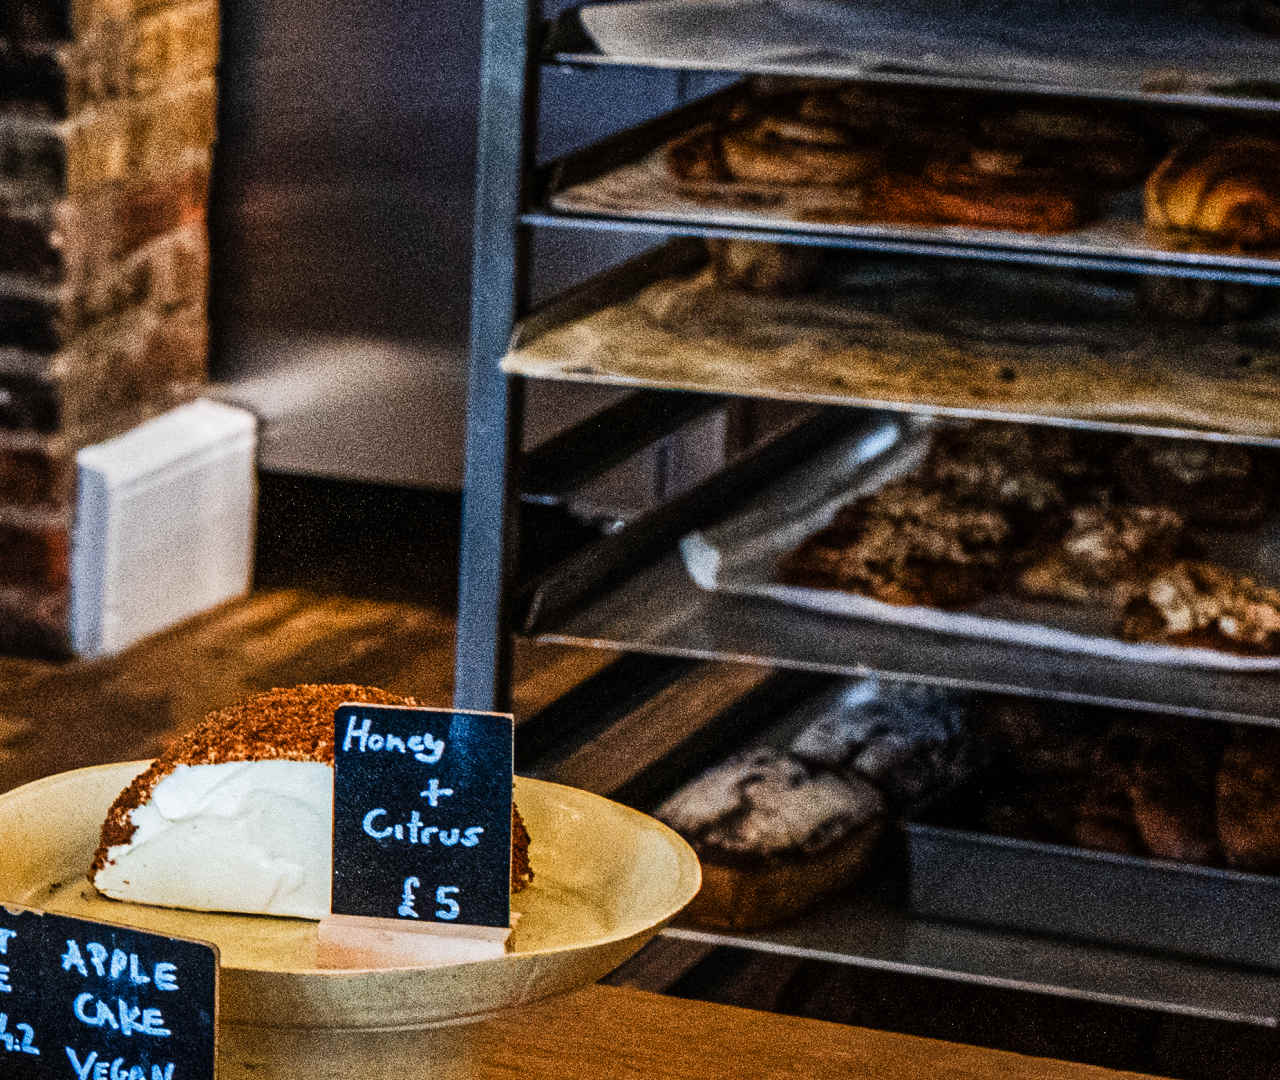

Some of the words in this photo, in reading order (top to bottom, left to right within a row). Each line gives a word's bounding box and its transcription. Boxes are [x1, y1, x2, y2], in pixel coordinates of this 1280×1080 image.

[341, 714, 446, 765] Honey
[361, 807, 485, 848] Citrus
[61, 938, 180, 992] APPLE
[72, 992, 172, 1037] CAKE
